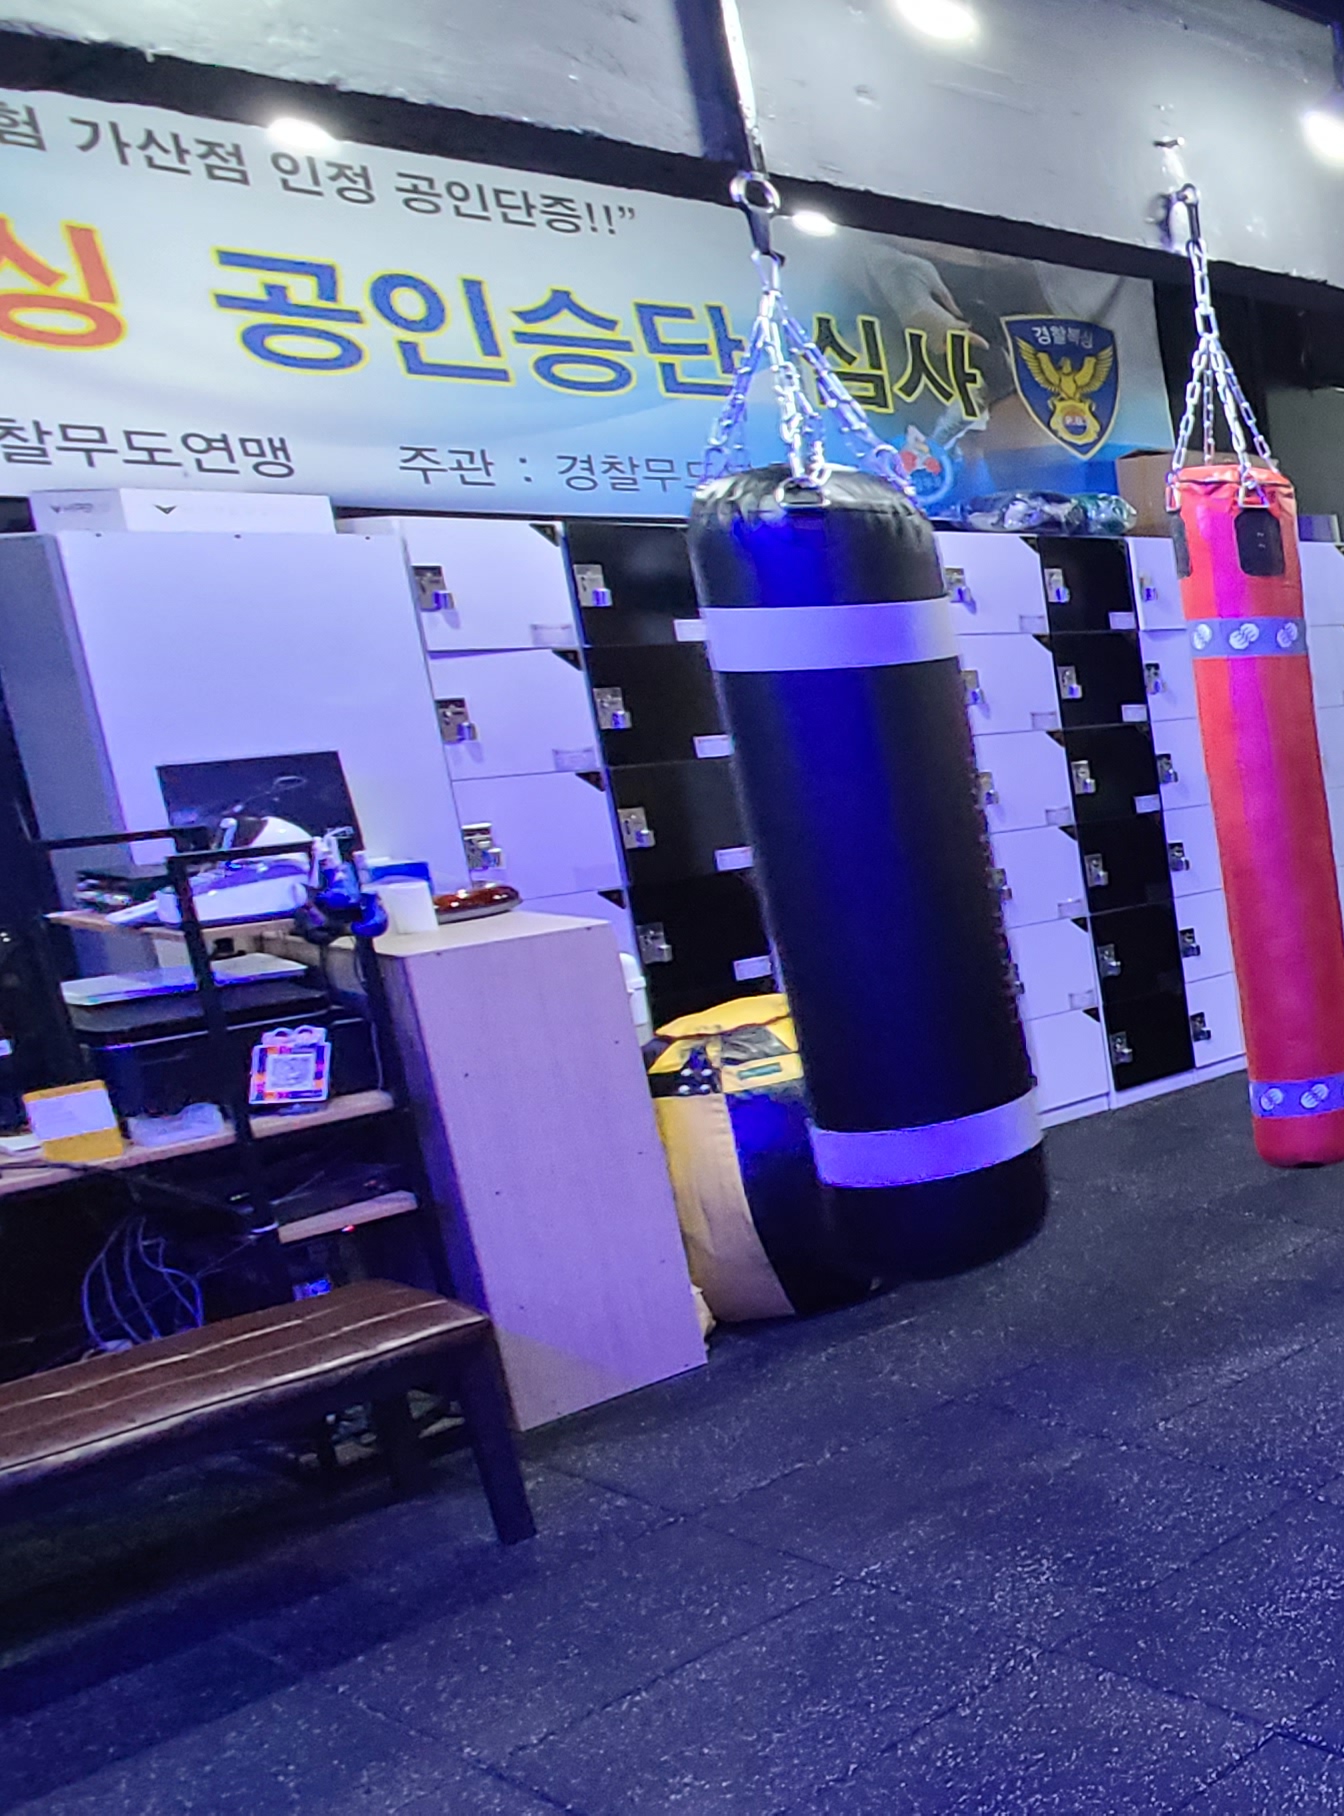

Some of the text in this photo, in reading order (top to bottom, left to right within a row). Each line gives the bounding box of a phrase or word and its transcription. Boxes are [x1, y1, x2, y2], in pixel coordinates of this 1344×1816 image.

[68, 116, 251, 186] 가산점
[269, 150, 376, 205] 인정
[212, 247, 983, 421] 공인승단 심사
[399, 446, 497, 487] 주관
